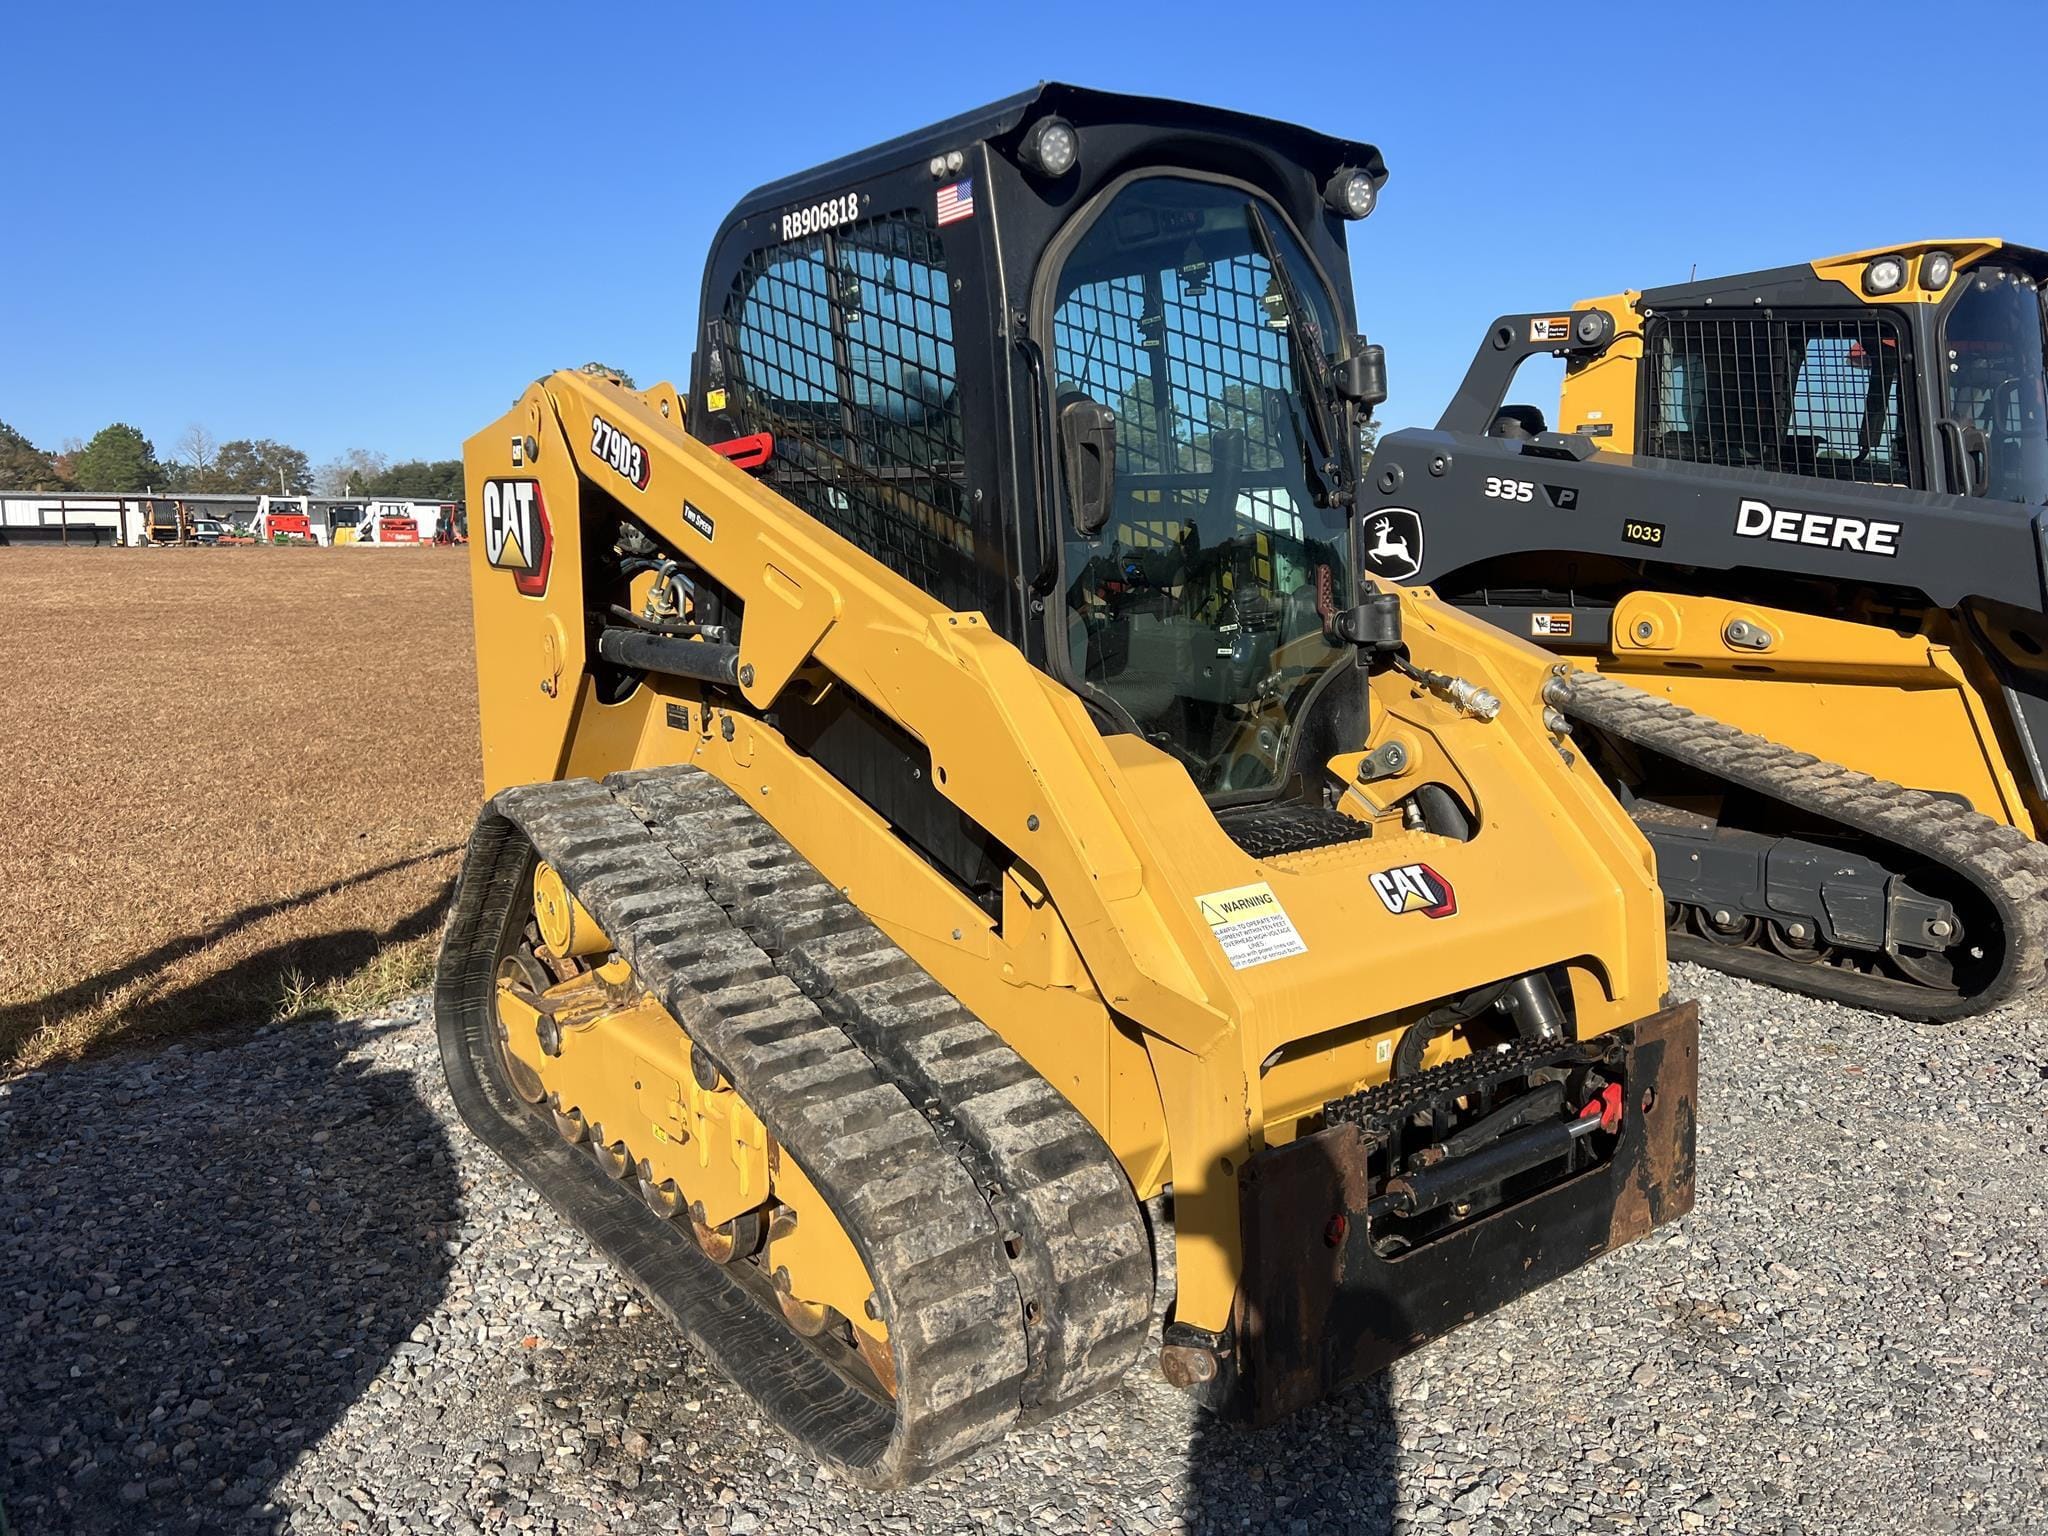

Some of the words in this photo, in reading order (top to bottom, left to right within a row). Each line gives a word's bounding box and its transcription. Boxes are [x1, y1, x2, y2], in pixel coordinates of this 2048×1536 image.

[782, 193, 859, 241] RB906818
[592, 415, 642, 484] 279D3
[1484, 477, 1534, 503] 335
[1557, 489, 1575, 506] P
[484, 480, 534, 568] CAT
[1626, 523, 1662, 542] 1033
[1736, 499, 1900, 555] DEERE
[1369, 864, 1440, 914] CAT
[1220, 893, 1273, 914] WARNING
[1242, 926, 1263, 935] WITHIN
[1271, 920, 1287, 928] FEET
[1245, 917, 1271, 927] OPERATE
[1223, 936, 1254, 948] OVERHEAD
[1257, 945, 1274, 953] power
